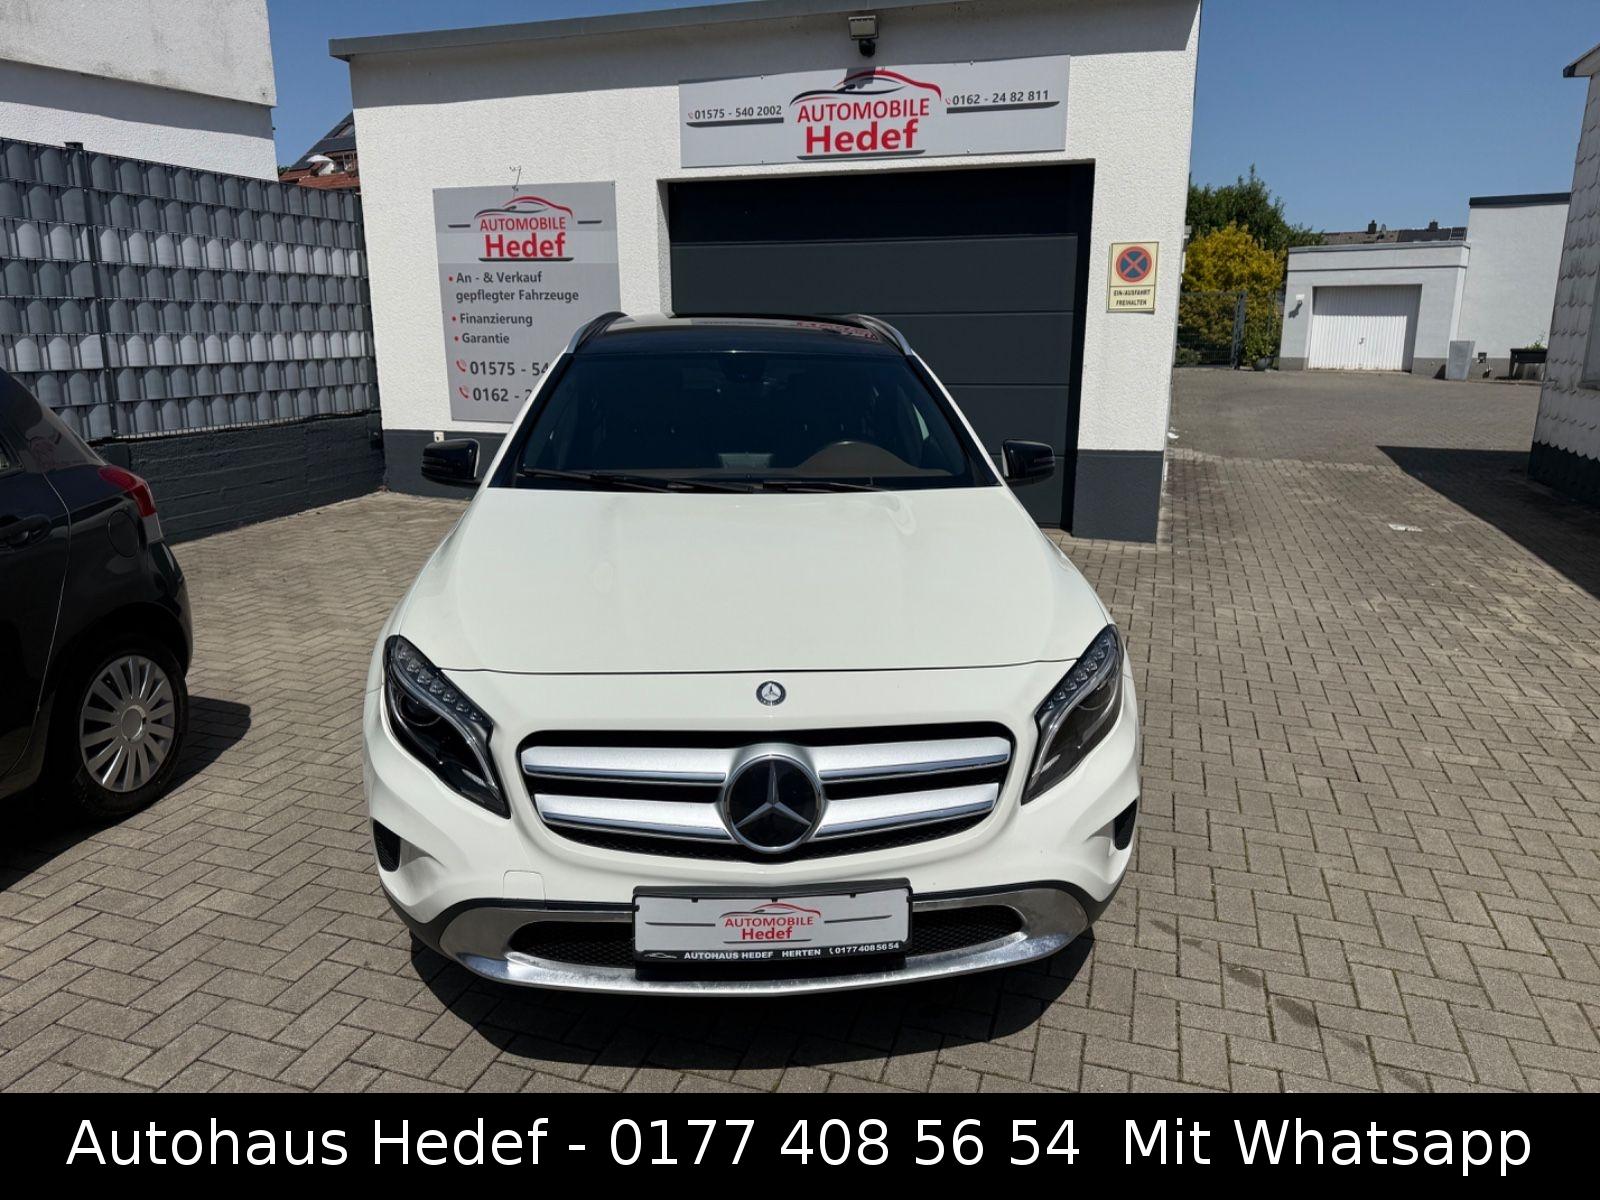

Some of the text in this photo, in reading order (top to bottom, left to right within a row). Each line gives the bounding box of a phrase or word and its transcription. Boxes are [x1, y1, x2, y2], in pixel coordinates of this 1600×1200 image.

[952, 92, 980, 105] 0162
[992, 92, 1007, 103] 24
[1009, 91, 1025, 103] 82
[1027, 90, 1049, 102] 811
[694, 107, 725, 121] 01575
[735, 106, 755, 118] 540
[756, 104, 782, 117] 2002
[797, 98, 930, 123] AUTOMOBILE
[806, 118, 920, 154] Hedef
[480, 216, 566, 231] AUTOMOBILE
[485, 232, 566, 258] Hedef
[456, 272, 472, 283] An
[483, 272, 494, 283] &
[496, 271, 543, 283] Verkauf
[456, 289, 579, 304] gepflegter Fahrzeuge
[460, 312, 533, 327] Finanzierung
[462, 332, 510, 344] Garantie
[470, 361, 515, 376] 01575
[473, 388, 509, 402] 0162
[724, 916, 814, 928] AUTOMOBILE
[741, 927, 793, 941] Hedef
[684, 950, 739, 960] AUTOHAUS
[741, 950, 774, 959] HEDEF
[782, 948, 821, 958] HERTEN
